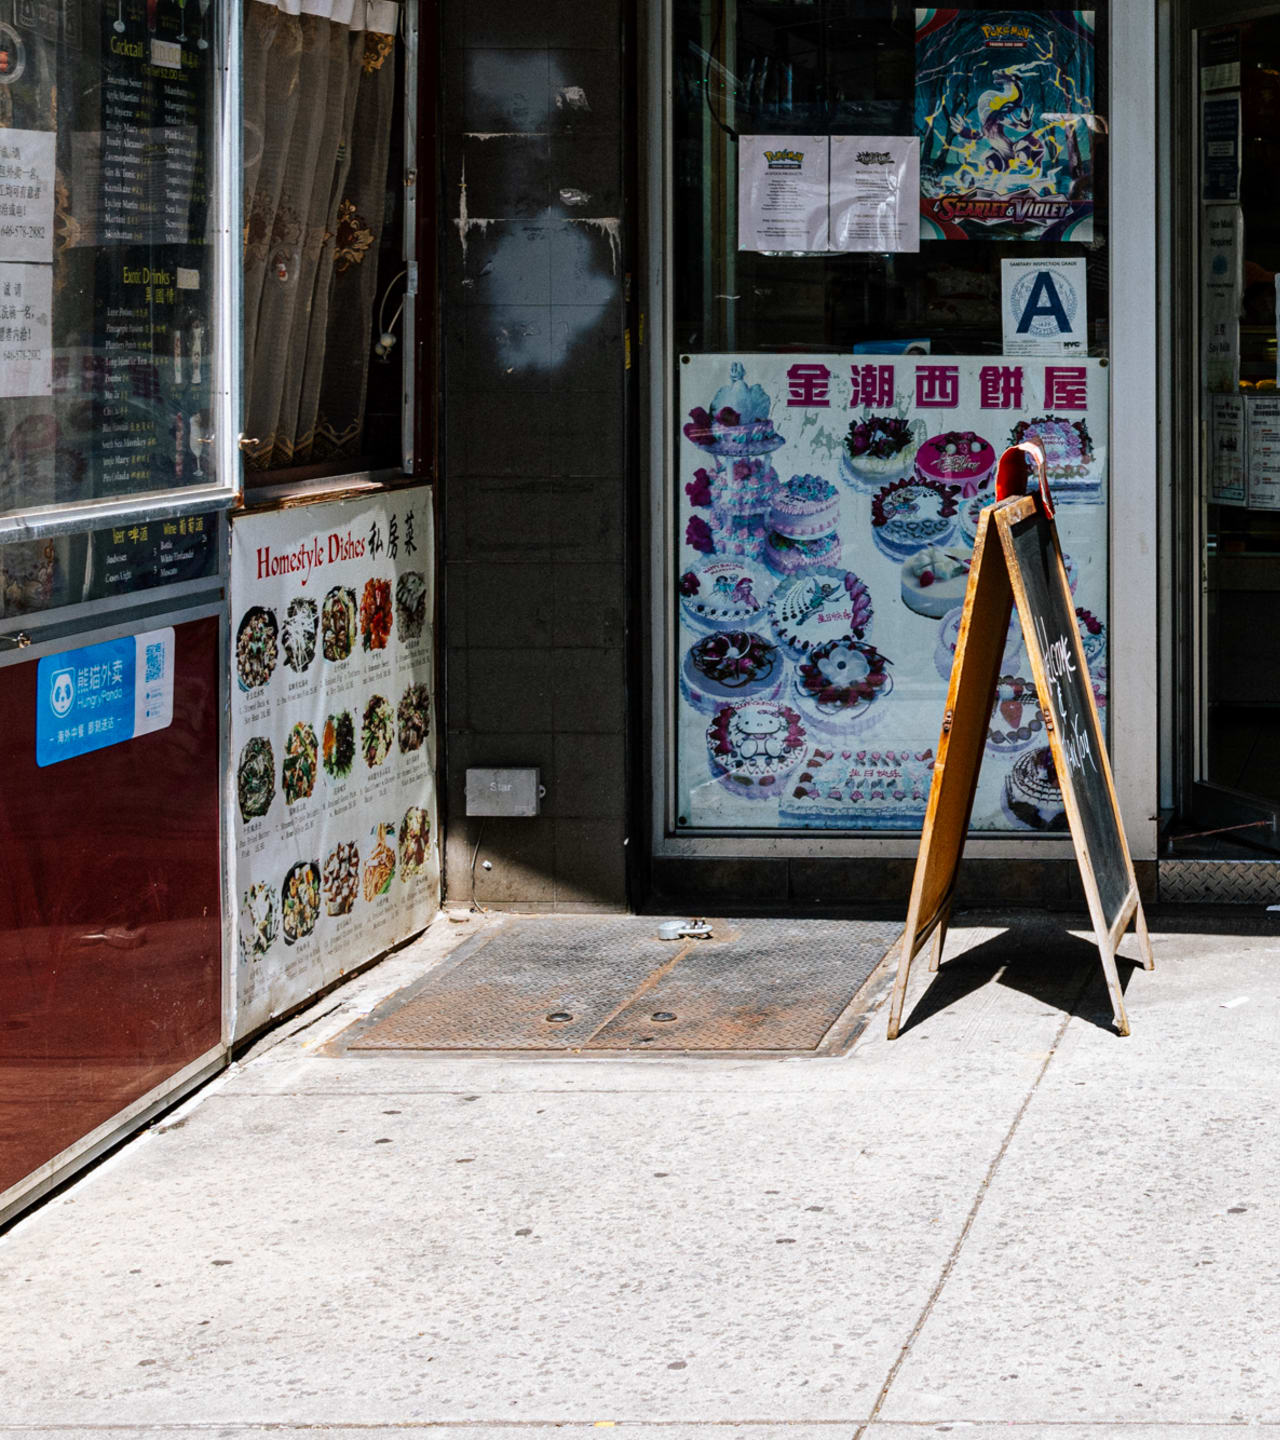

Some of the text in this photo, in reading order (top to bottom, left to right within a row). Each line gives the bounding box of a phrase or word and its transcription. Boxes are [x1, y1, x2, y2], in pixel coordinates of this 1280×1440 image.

[1015, 270, 1073, 334] A
[785, 363, 1090, 412] 金潮西餅屋
[256, 509, 418, 587] Homestyle Dishes 私房菜
